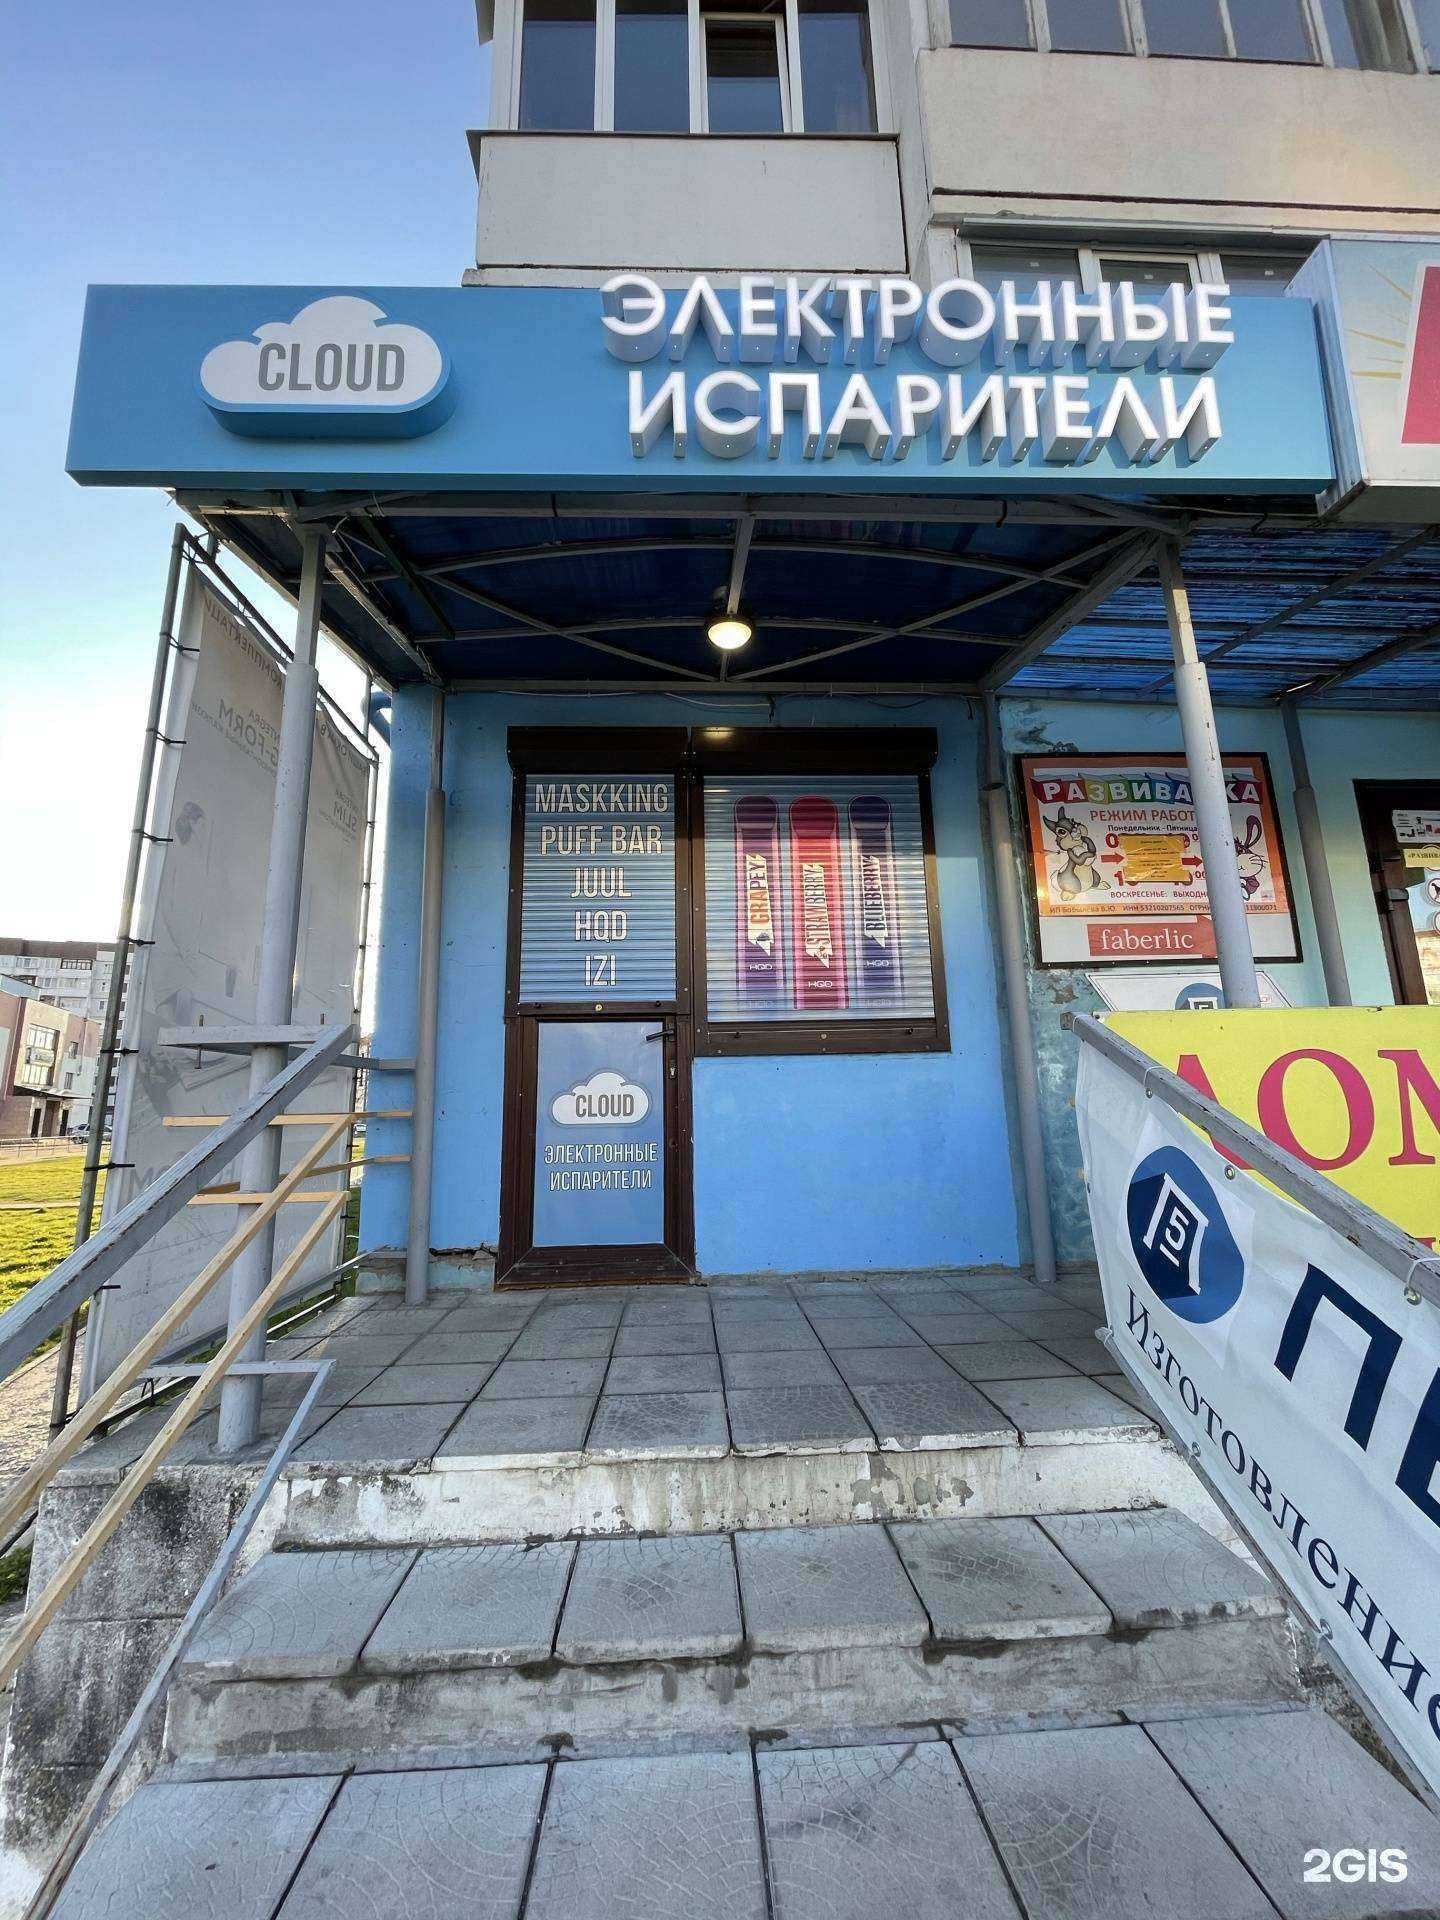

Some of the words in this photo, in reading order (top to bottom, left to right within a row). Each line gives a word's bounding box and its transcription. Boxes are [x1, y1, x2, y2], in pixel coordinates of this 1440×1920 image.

[601, 273, 1233, 347] ЭЛЕКТРОННЫЕ
[258, 342, 406, 393] CLOUD
[628, 370, 1219, 445] ИСПАРИТЕЛИ
[535, 783, 668, 813] MASKKING
[1042, 781, 1260, 802] РАЗВИВАКА
[1090, 810, 1146, 821] РЕЖИМ
[1151, 810, 1195, 821] РАБОТ
[1108, 824, 1160, 832] Понедельник
[541, 825, 603, 855] PUFF
[611, 825, 663, 855] BAR
[570, 867, 632, 898] JUUL
[749, 863, 771, 924] GRAPEY
[804, 868, 831, 945] STRAWBERRY
[575, 910, 627, 943] HQD
[1101, 928, 1194, 950] faberlic
[585, 955, 616, 986] IZI
[575, 1093, 635, 1118] CLOUD
[544, 1142, 658, 1165] ЭЛЕКТРОННЫЕ
[550, 1169, 652, 1191] ИСПАРИТЕЛИ
